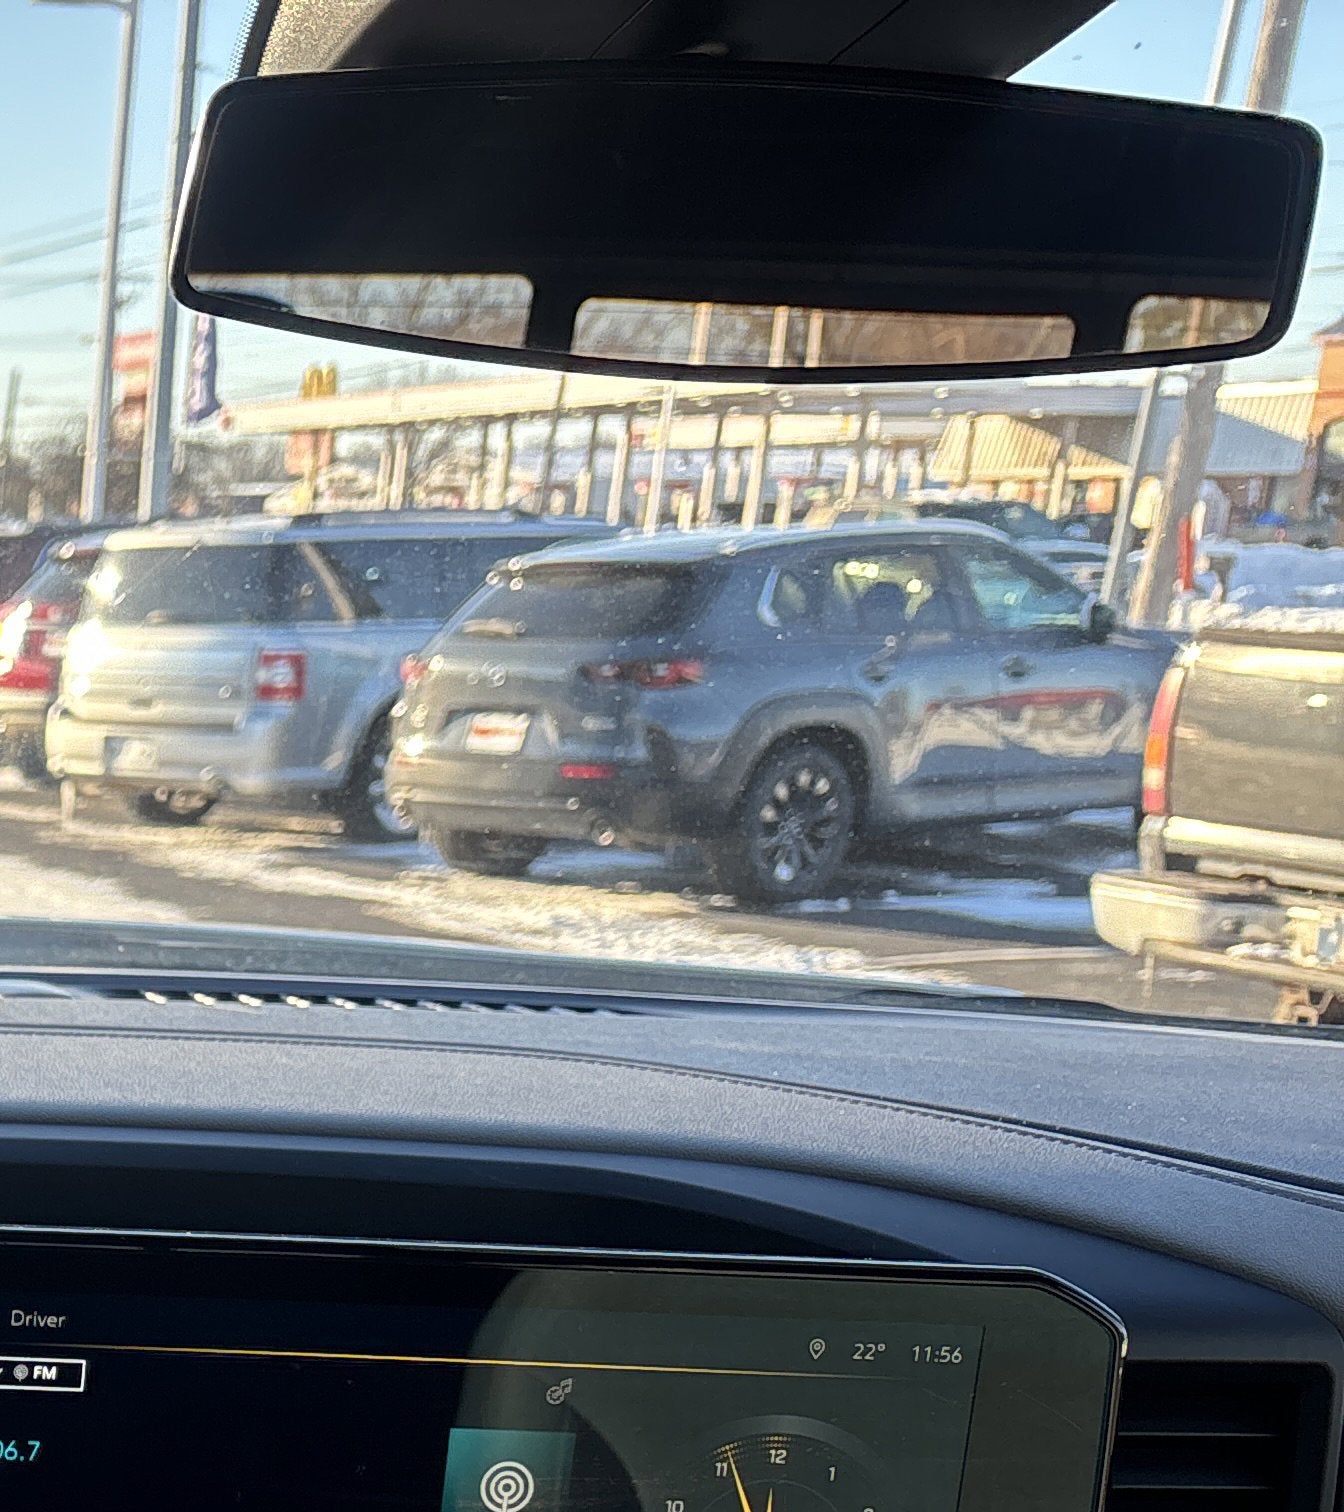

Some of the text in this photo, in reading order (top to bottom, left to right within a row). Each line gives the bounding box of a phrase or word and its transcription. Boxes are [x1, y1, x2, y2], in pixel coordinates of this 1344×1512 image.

[10, 1309, 66, 1328] Driver
[912, 1345, 962, 1364] 11:56
[32, 1364, 57, 1381] FM
[769, 1449, 787, 1465] 12
[715, 1462, 728, 1478] 11
[828, 1466, 837, 1482] 1
